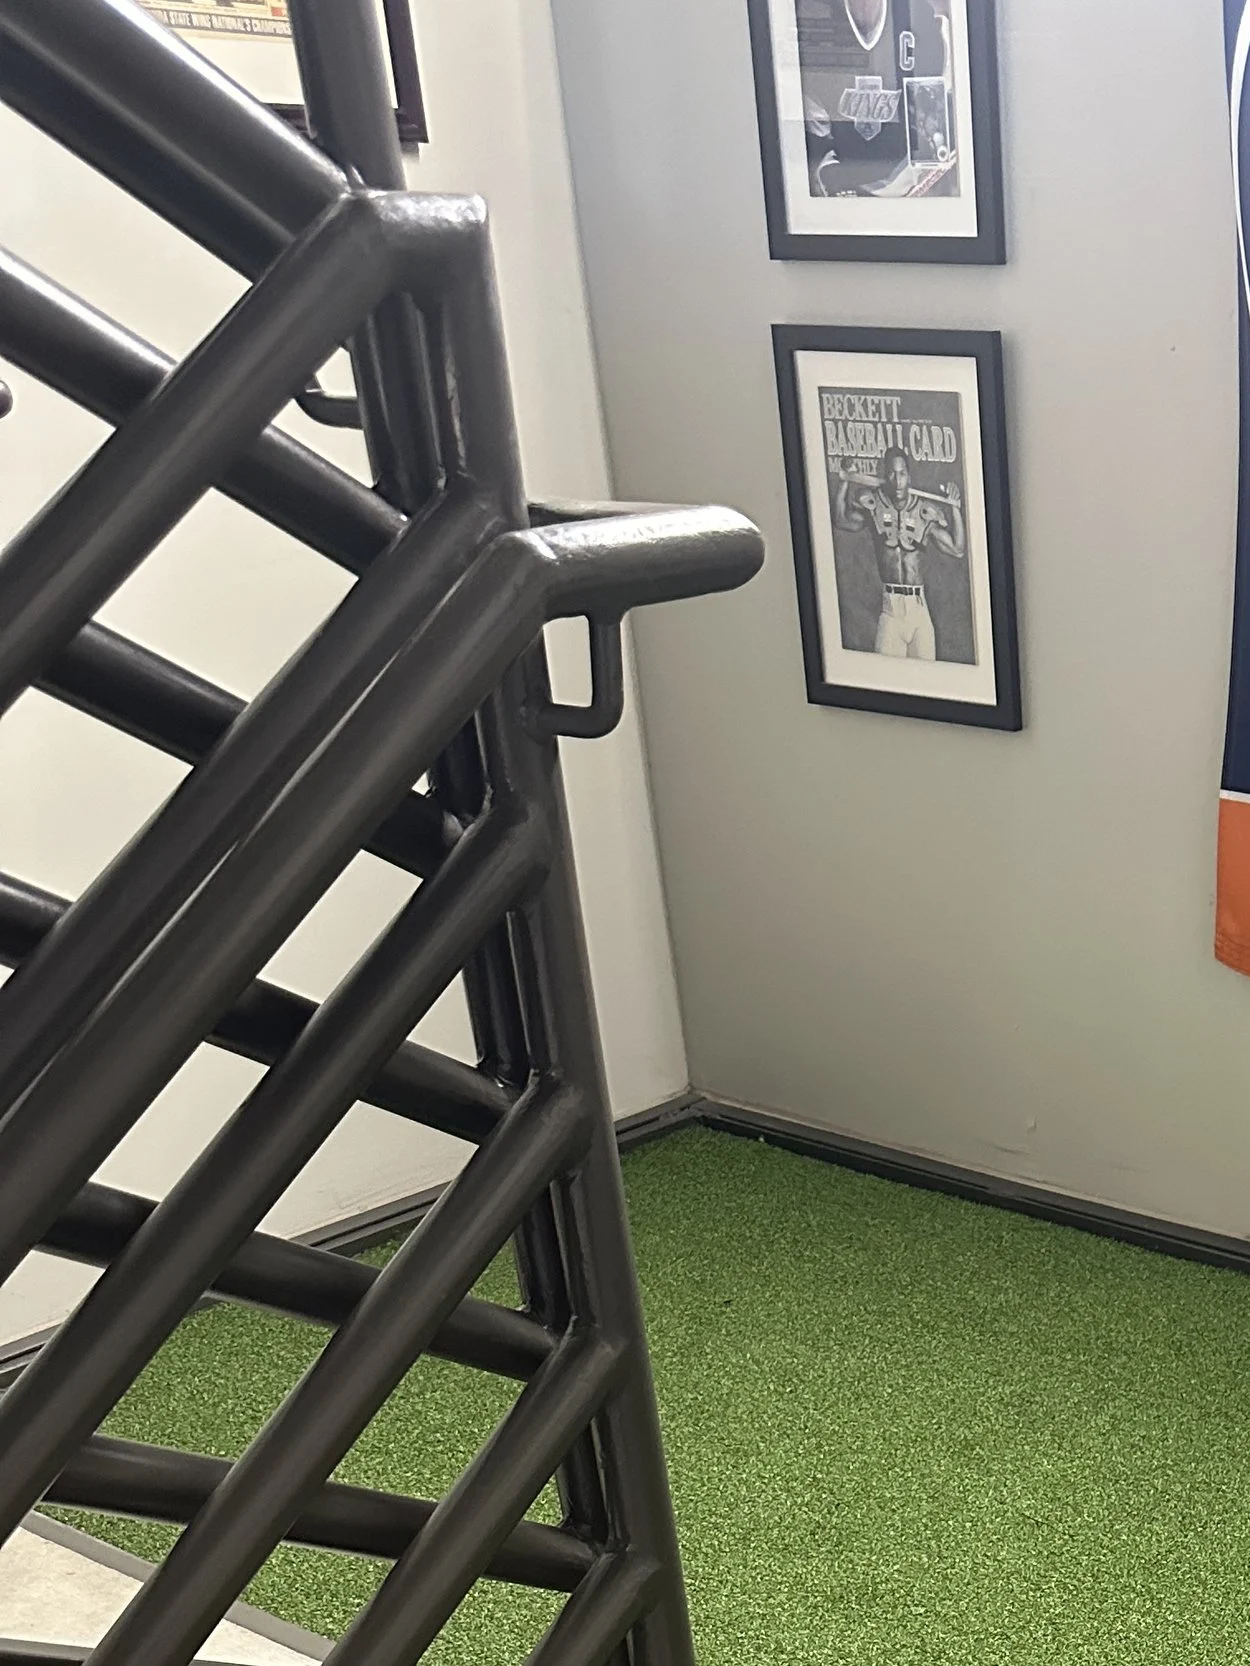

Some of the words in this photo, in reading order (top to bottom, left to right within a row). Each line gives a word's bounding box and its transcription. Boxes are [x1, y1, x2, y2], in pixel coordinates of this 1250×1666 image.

[821, 393, 901, 422] BECKETT
[909, 424, 957, 463] CARD
[827, 456, 878, 475] MTHLY
